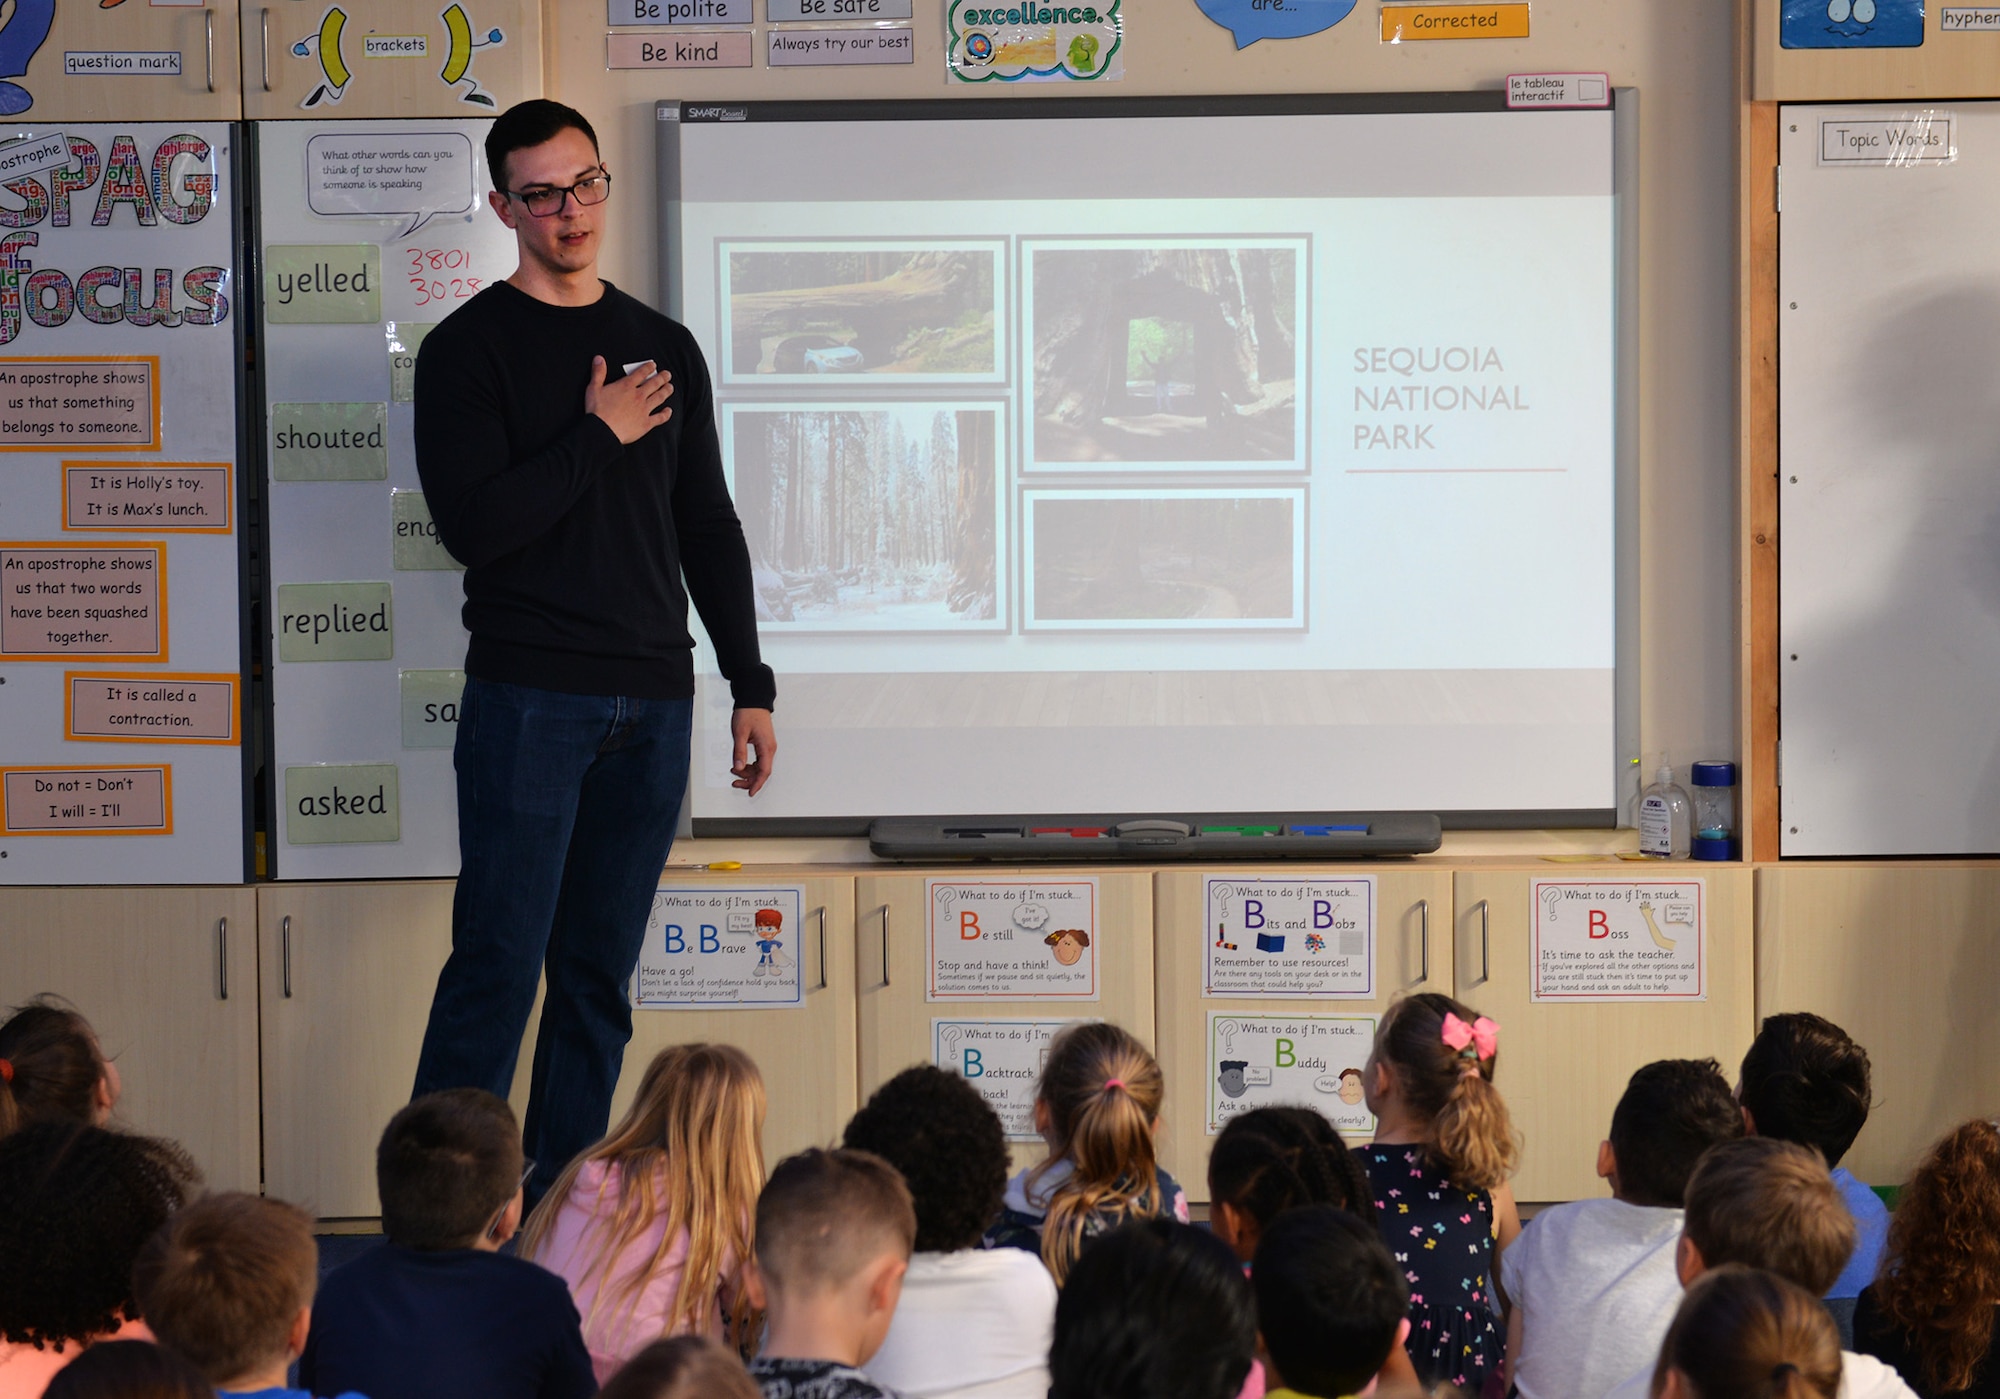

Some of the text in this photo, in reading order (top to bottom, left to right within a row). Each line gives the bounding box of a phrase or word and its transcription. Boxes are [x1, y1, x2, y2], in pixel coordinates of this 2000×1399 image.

[635, 0, 727, 23] Be polite
[801, 0, 826, 13] Be
[964, 2, 1103, 25] excellence.
[1414, 12, 1497, 28] Corrected
[367, 40, 425, 51] brackets
[642, 42, 718, 61] Be kind
[772, 36, 909, 53] Always try our best
[68, 55, 178, 71] question mark
[1511, 78, 1564, 88] le tableau
[1512, 90, 1564, 100] interactif
[689, 108, 721, 117] SMART
[1837, 130, 1939, 152] Topic Words
[0, 145, 60, 170] ostrophe
[322, 151, 349, 159] What
[352, 151, 377, 159] other
[380, 150, 410, 159] words
[434, 152, 452, 161] you
[351, 166, 359, 176] of
[363, 166, 373, 174] to
[376, 165, 403, 173] show
[405, 164, 427, 173] how
[369, 180, 377, 188] is
[380, 179, 422, 191] speaking
[407, 248, 469, 275] 3801
[278, 263, 369, 303] yelled
[410, 278, 483, 305] 3028
[1354, 347, 1504, 376] SEQUOIA
[0, 371, 145, 387] An apostrophe shows
[9, 396, 134, 411] us that something
[1354, 386, 1529, 411] NATIONAL
[2, 421, 142, 436] belongs to someone.
[276, 424, 383, 448] shouted
[1354, 424, 1435, 449] PARK
[91, 477, 203, 492] It is Holly's toy.
[88, 504, 207, 515] It is Max's lunch.
[5, 557, 152, 573] An apostrophe shows
[16, 582, 141, 594] us that two words
[11, 606, 148, 621] have been squashed
[283, 603, 388, 644] replied
[47, 631, 112, 646] together.
[107, 688, 196, 701] It is called a
[109, 713, 193, 726] contraction.
[425, 702, 460, 722] sa
[36, 780, 53, 791] Do
[58, 779, 80, 791] not
[98, 778, 133, 790] Don't
[299, 786, 386, 816] asked
[49, 806, 57, 817] I
[62, 805, 84, 817] will
[959, 891, 986, 899] What
[990, 891, 999, 899] to
[1004, 890, 1015, 899] do
[1020, 890, 1026, 902] if
[1029, 890, 1044, 899] I'm
[1236, 888, 1263, 897] What
[1267, 888, 1277, 896] to
[1281, 888, 1293, 896] do
[1297, 888, 1303, 899] if
[1307, 888, 1321, 897] I'm
[1565, 891, 1591, 899] What
[1596, 891, 1605, 899] to
[1610, 890, 1621, 899] do
[1625, 890, 1631, 902] if
[1635, 890, 1650, 899] I'm
[665, 897, 692, 906] What
[696, 898, 705, 906] to
[710, 897, 721, 906] do
[725, 897, 731, 909] if
[735, 897, 750, 906] I'm
[1245, 900, 1279, 928] Bits
[1285, 919, 1306, 929] and
[960, 911, 1013, 940] Be still
[1589, 910, 1629, 938] Boss
[665, 925, 746, 953] Be Brave
[1543, 950, 1674, 959] It's time to ask the teacher.
[938, 961, 960, 971] Stop
[964, 960, 982, 969] and
[986, 960, 1008, 969] have
[1022, 960, 1048, 969] think!
[1215, 958, 1264, 966] Remember
[1269, 958, 1278, 966] to
[1302, 958, 1348, 967] resources!
[1542, 963, 1548, 972] If
[1575, 963, 1604, 972] explored
[1653, 963, 1678, 972] options
[642, 967, 666, 975] Have
[680, 967, 693, 978] go!
[1241, 1024, 1268, 1034] What
[1272, 1025, 1281, 1033] to
[1286, 1025, 1297, 1034] do
[1302, 1025, 1308, 1037] if
[1311, 1025, 1327, 1034] I'm
[1276, 1039, 1326, 1072] Buddy
[964, 1049, 1033, 1078] Backtrack
[984, 1090, 1008, 1099] back!
[1338, 1116, 1365, 1125] clearly?
